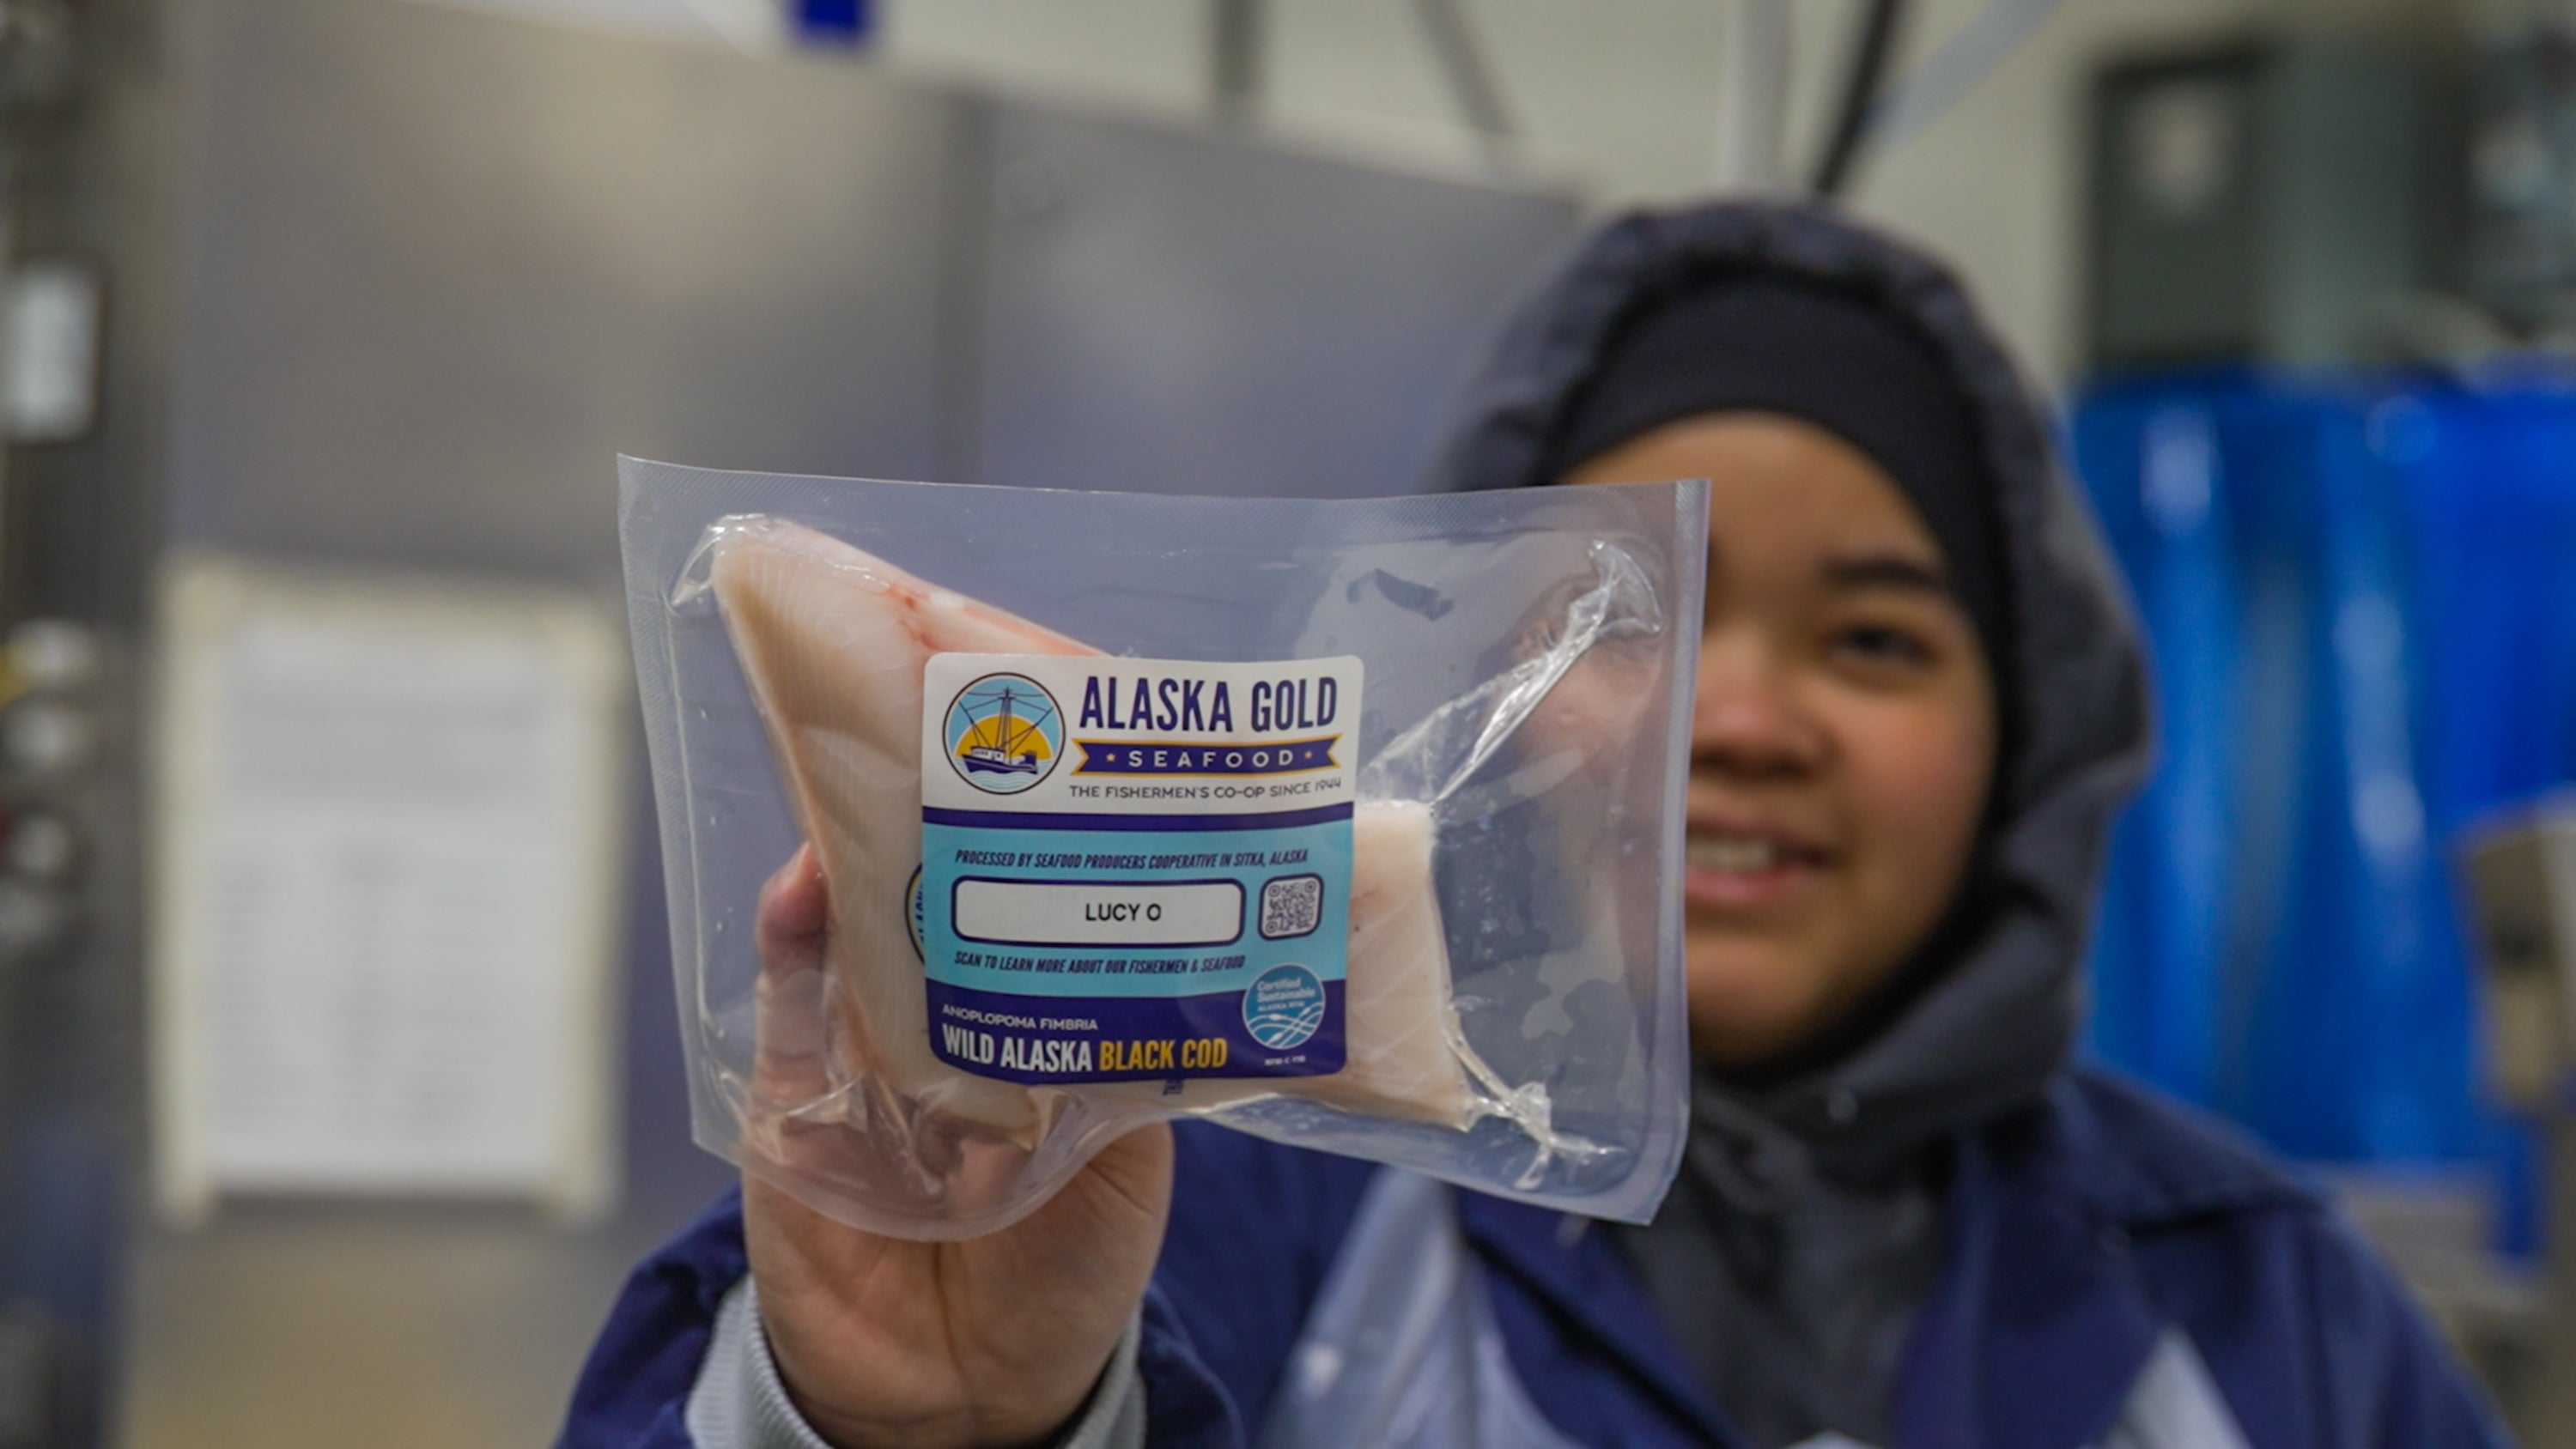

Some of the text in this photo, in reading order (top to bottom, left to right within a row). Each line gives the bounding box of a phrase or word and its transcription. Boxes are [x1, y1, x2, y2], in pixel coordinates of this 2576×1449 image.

[1079, 676, 1338, 733] ALASKA GOLD
[1127, 749, 1294, 768] SEAFOOD
[1070, 778, 1342, 799] THE FISHERMEN'S CO-OP SINCE 1944
[955, 849, 1309, 870] PROCESSED BY SEAFOOD PRODUCERS COOPERATIVE IN SITKA, ALASKA
[1085, 903, 1140, 921] LUCY
[955, 951, 1246, 974] SCAN TO LEARN MORE ABOUT OUR FISHERMEN & SEAFOOD
[1258, 977, 1302, 991] Certified
[1257, 988, 1315, 1003] Sustainable
[942, 1004, 1098, 1031] ANOPLOPOMA FIMBRIA
[942, 1023, 1227, 1073] WILD ALASKA BLACK COD
